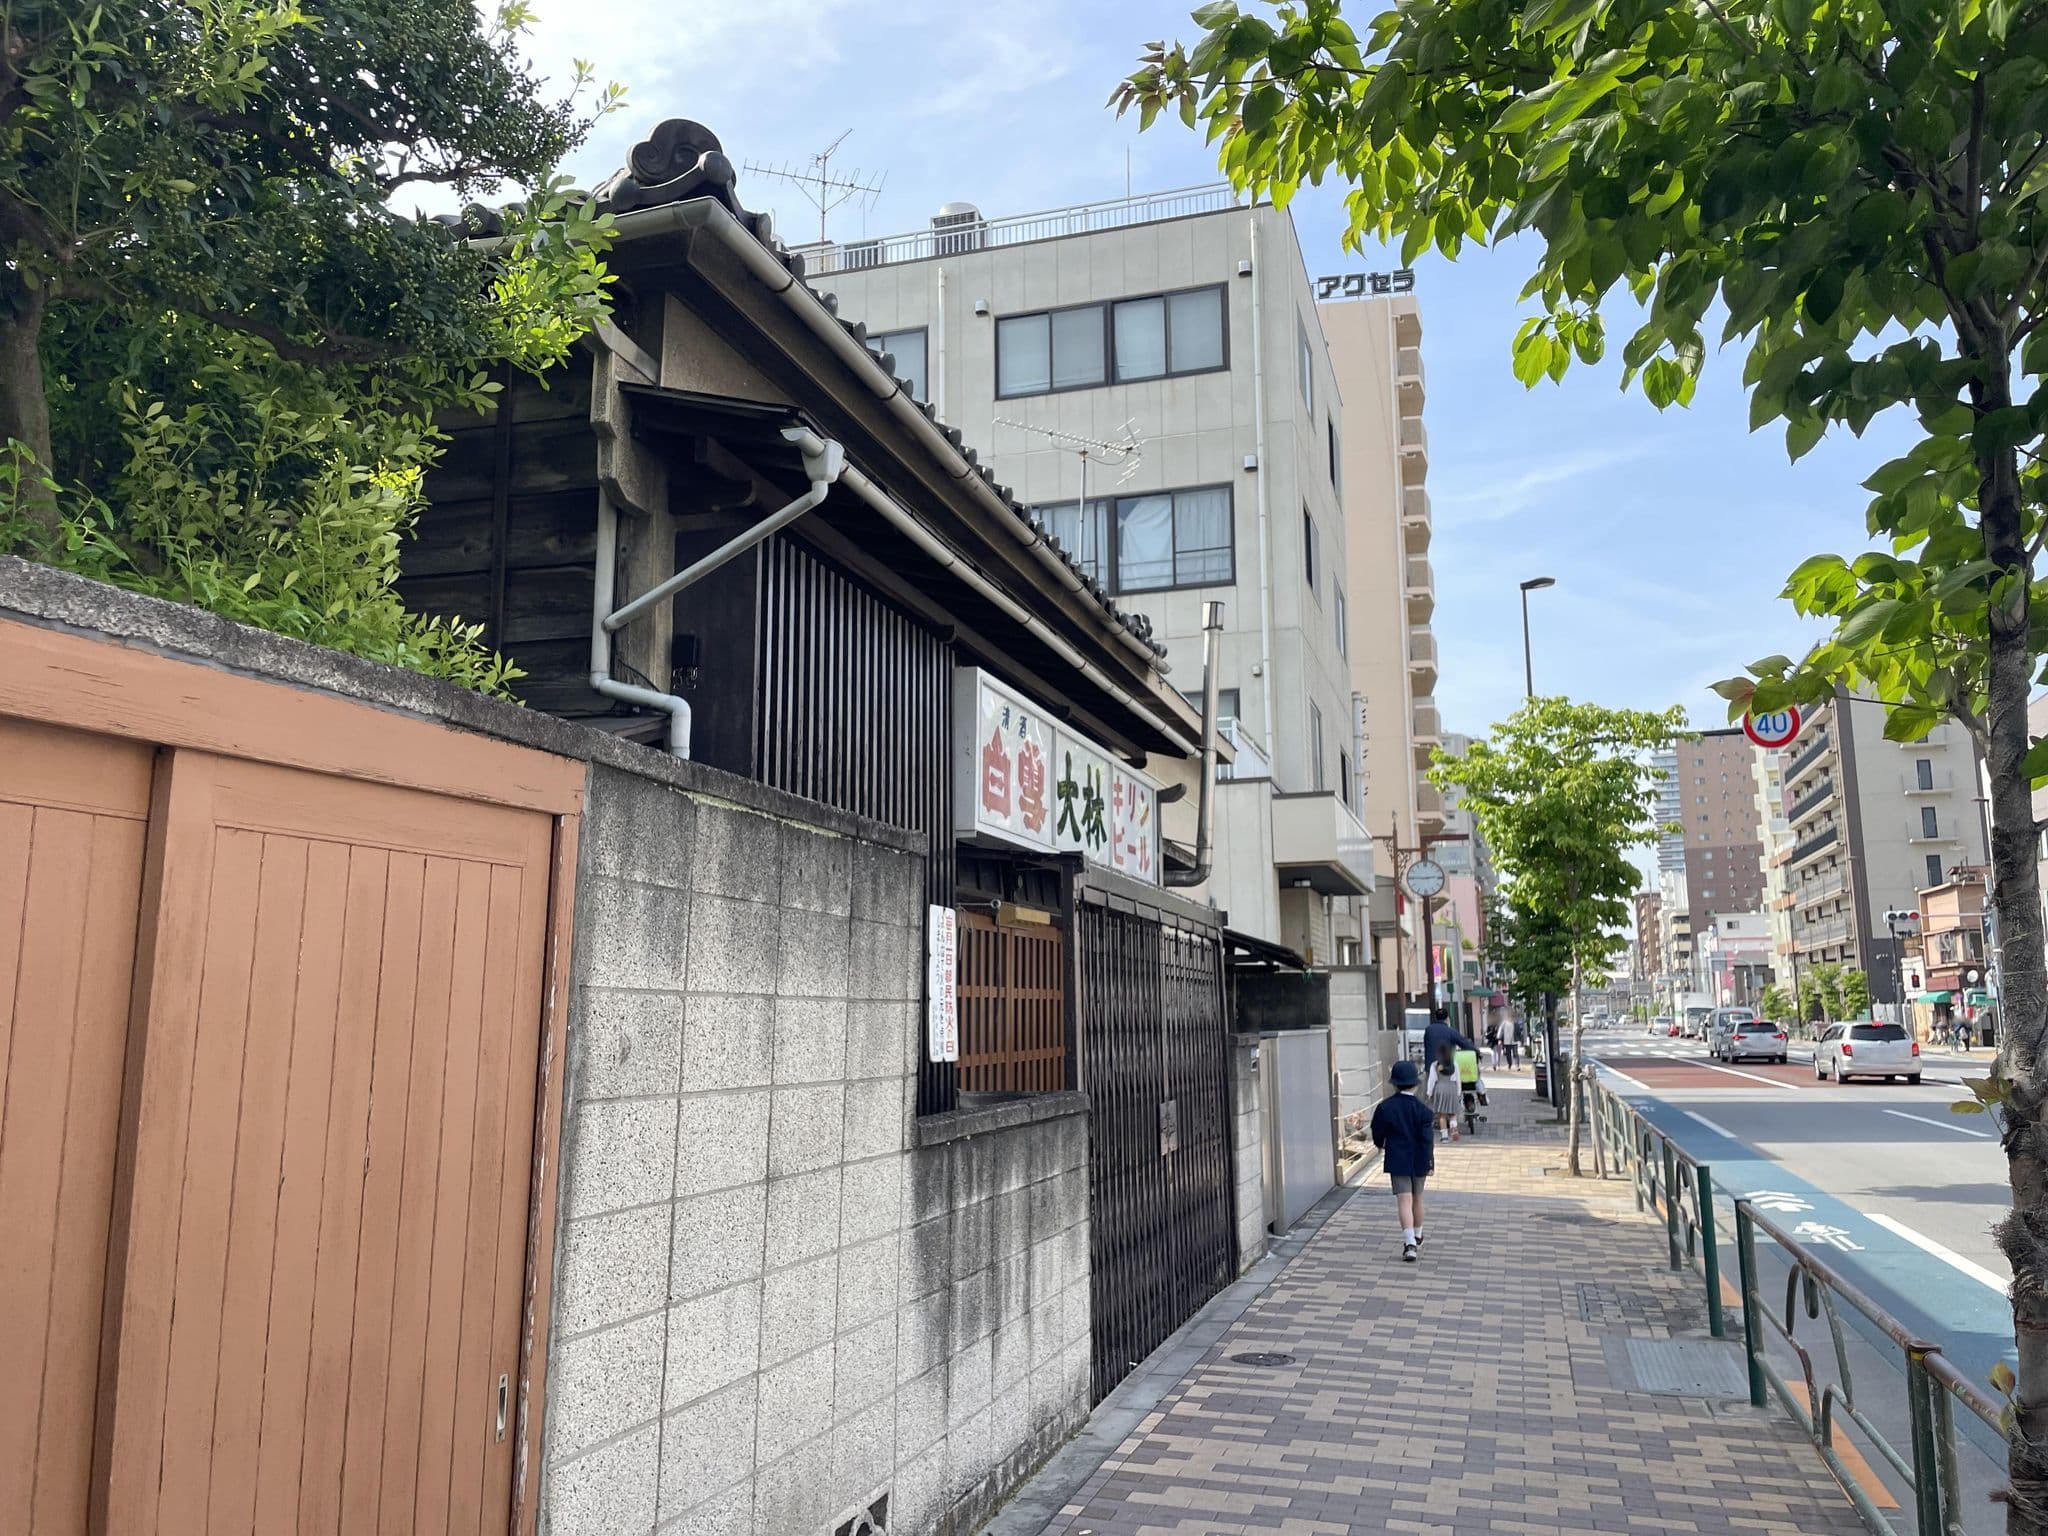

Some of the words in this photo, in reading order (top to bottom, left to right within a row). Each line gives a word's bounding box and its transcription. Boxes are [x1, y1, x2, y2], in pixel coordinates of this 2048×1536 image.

[1318, 269, 1415, 298] アクセラ
[1757, 712, 1788, 734] 40
[1057, 750, 1107, 852] 大林
[1113, 775, 1150, 827] キリン
[1113, 822, 1151, 873] ビール
